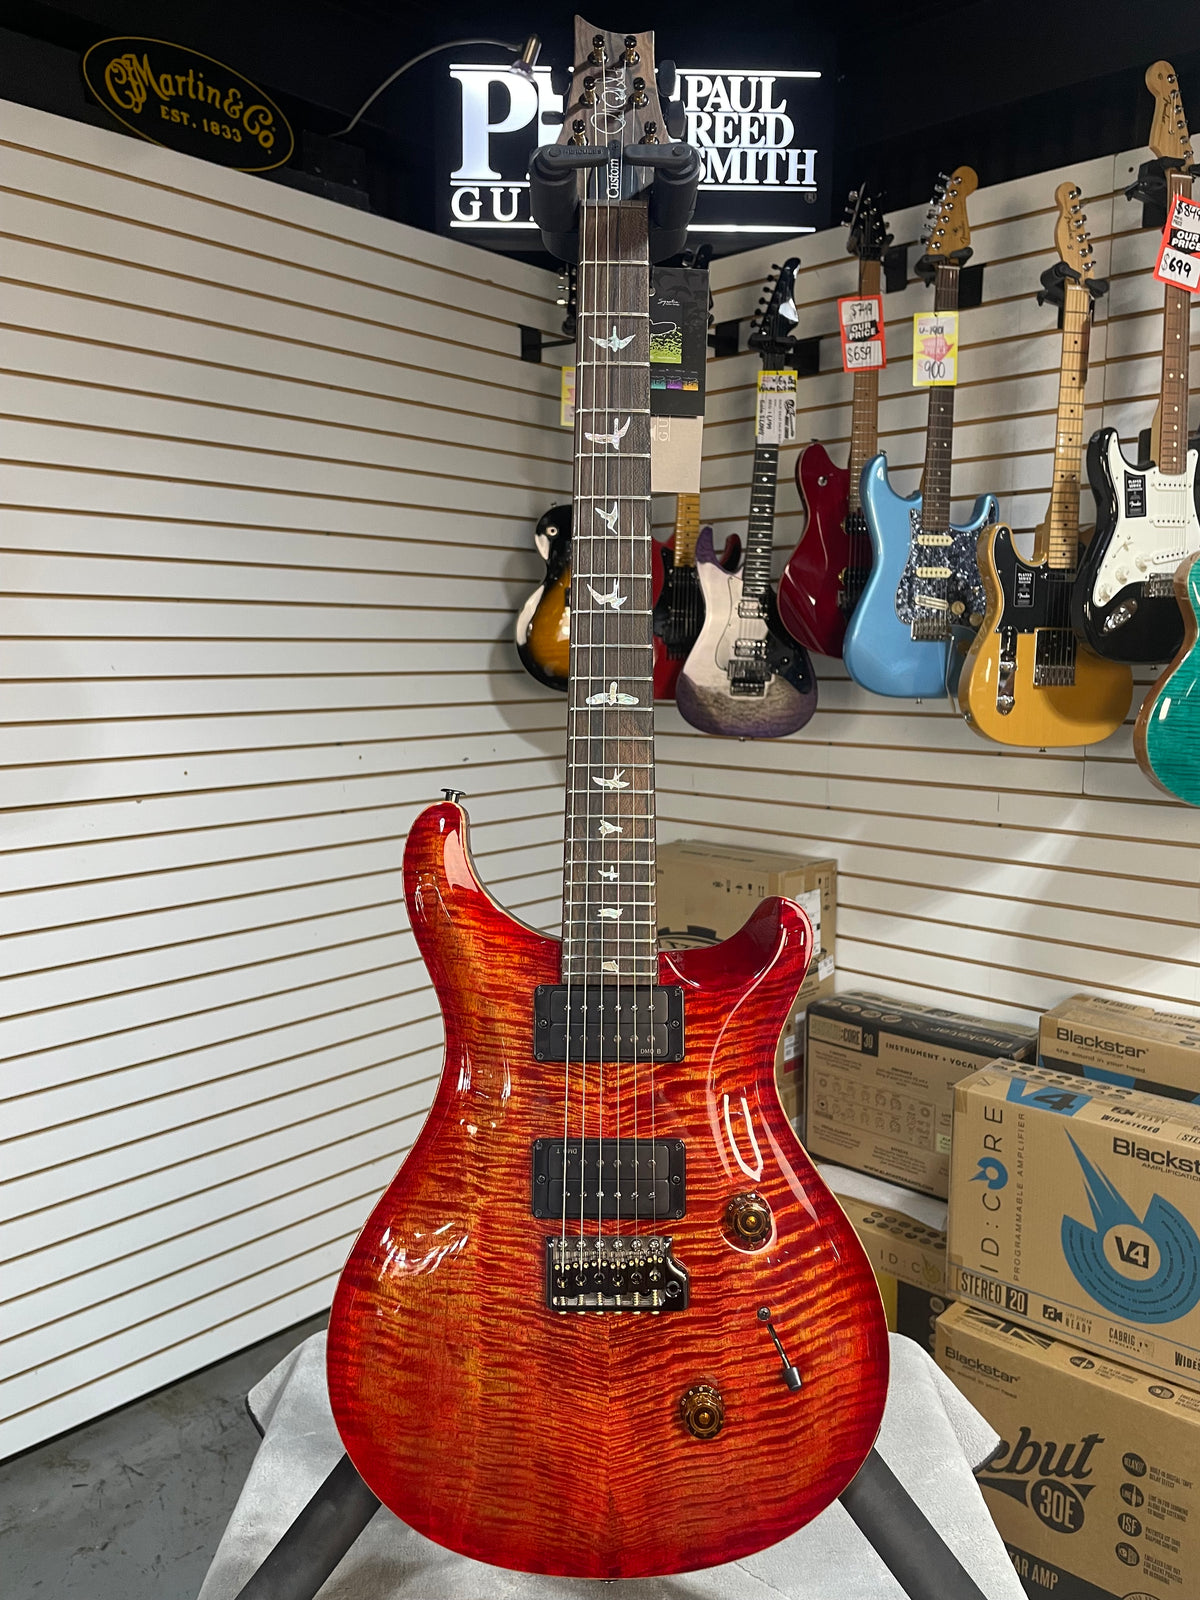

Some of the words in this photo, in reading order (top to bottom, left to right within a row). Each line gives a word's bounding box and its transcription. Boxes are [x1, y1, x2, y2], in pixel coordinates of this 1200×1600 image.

[684, 75, 787, 112] PAUL
[160, 105, 196, 129] EST.
[203, 119, 242, 143] 1833
[686, 112, 795, 148] REED
[606, 158, 620, 199] Custom
[1171, 237, 1200, 252] PRICE
[1177, 230, 1200, 243] OUR
[1161, 253, 1192, 278] $699
[849, 328, 876, 341] PRICE
[851, 321, 871, 333] OUR
[924, 361, 946, 380] 900
[885, 1041, 940, 1061] INSTRUMENT
[949, 1057, 978, 1071] VOCAL
[1056, 1026, 1148, 1059] Blackstar
[1005, 1077, 1090, 1116] V4
[1017, 1112, 1026, 1178] AMPLIFIER
[1141, 1162, 1200, 1182] AMPLIFICATIO
[1013, 1183, 1025, 1282] PROGRAMMABLE
[1114, 1235, 1150, 1270] V4
[961, 1272, 1002, 1305] STEREO
[1009, 1289, 1025, 1313] 20
[1065, 1317, 1093, 1336] READY
[1108, 1327, 1136, 1347] CABRIG
[945, 1346, 1019, 1384] Blackstar
[985, 1426, 1106, 1480] ebut
[1040, 1485, 1076, 1529] 30E
[1121, 1514, 1138, 1535] ISF
[1031, 1564, 1059, 1591] AMP
